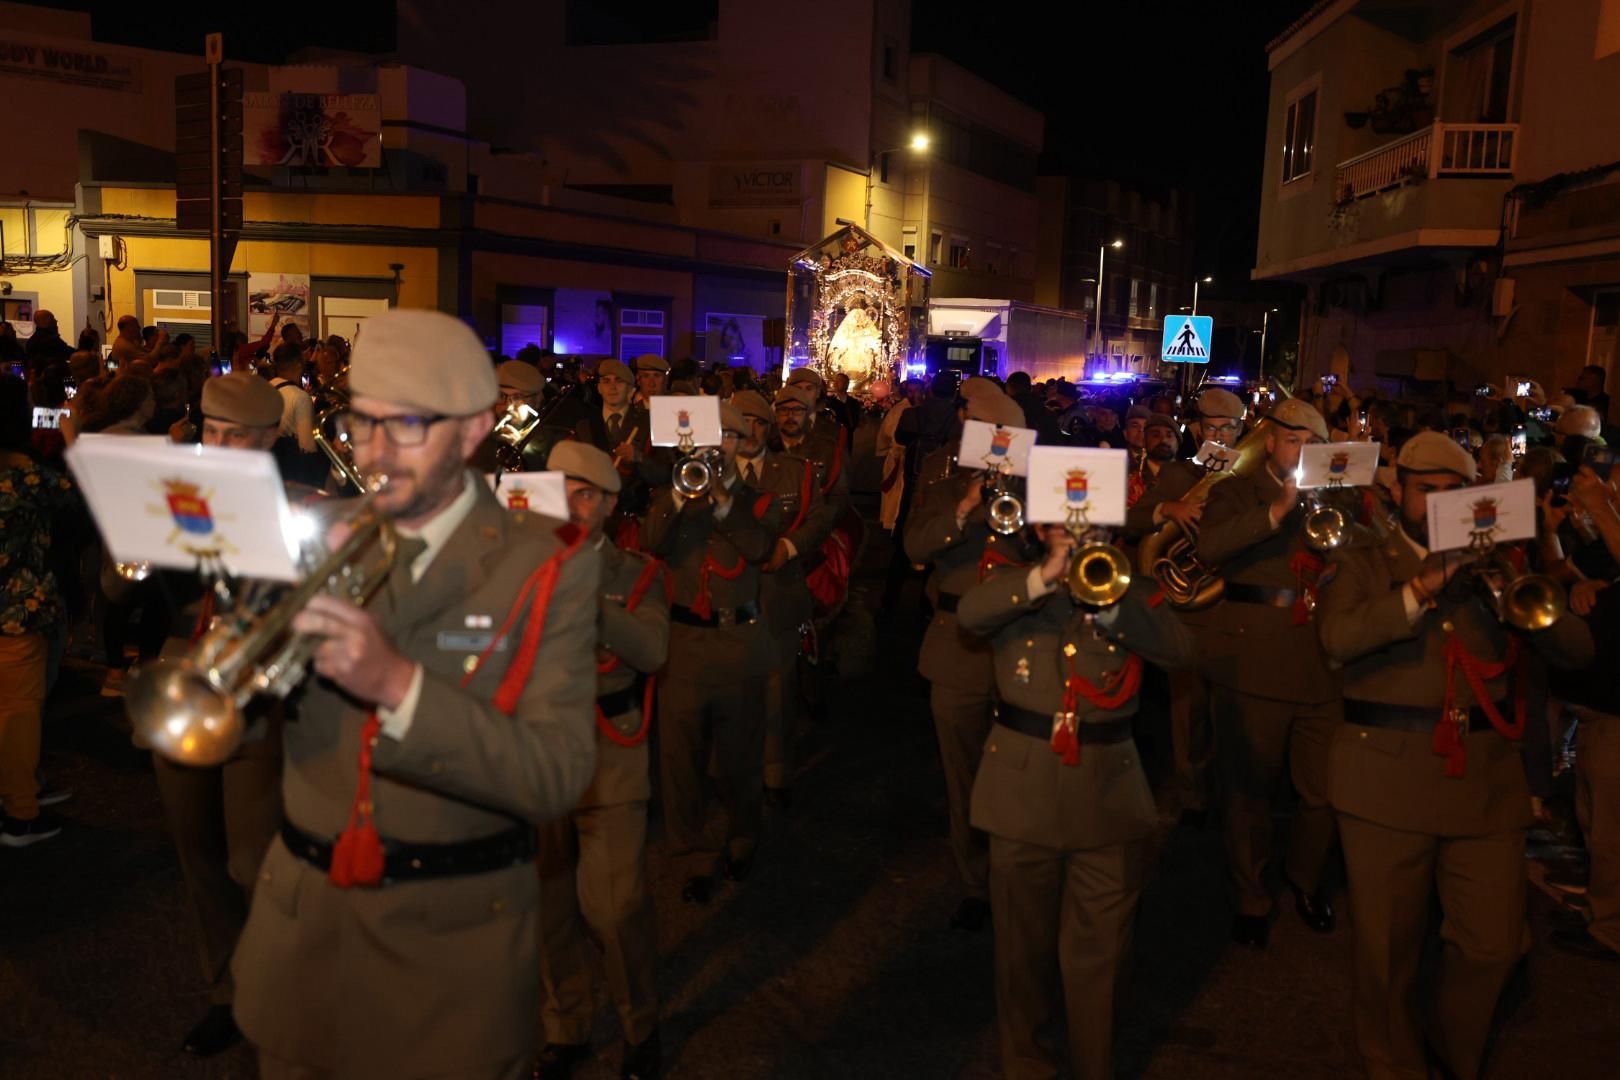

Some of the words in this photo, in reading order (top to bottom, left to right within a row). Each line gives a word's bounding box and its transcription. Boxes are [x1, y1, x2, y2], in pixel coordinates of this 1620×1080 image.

[42, 47, 108, 73] WORLD
[295, 95, 315, 109] DE
[319, 95, 377, 109] BELLEZA
